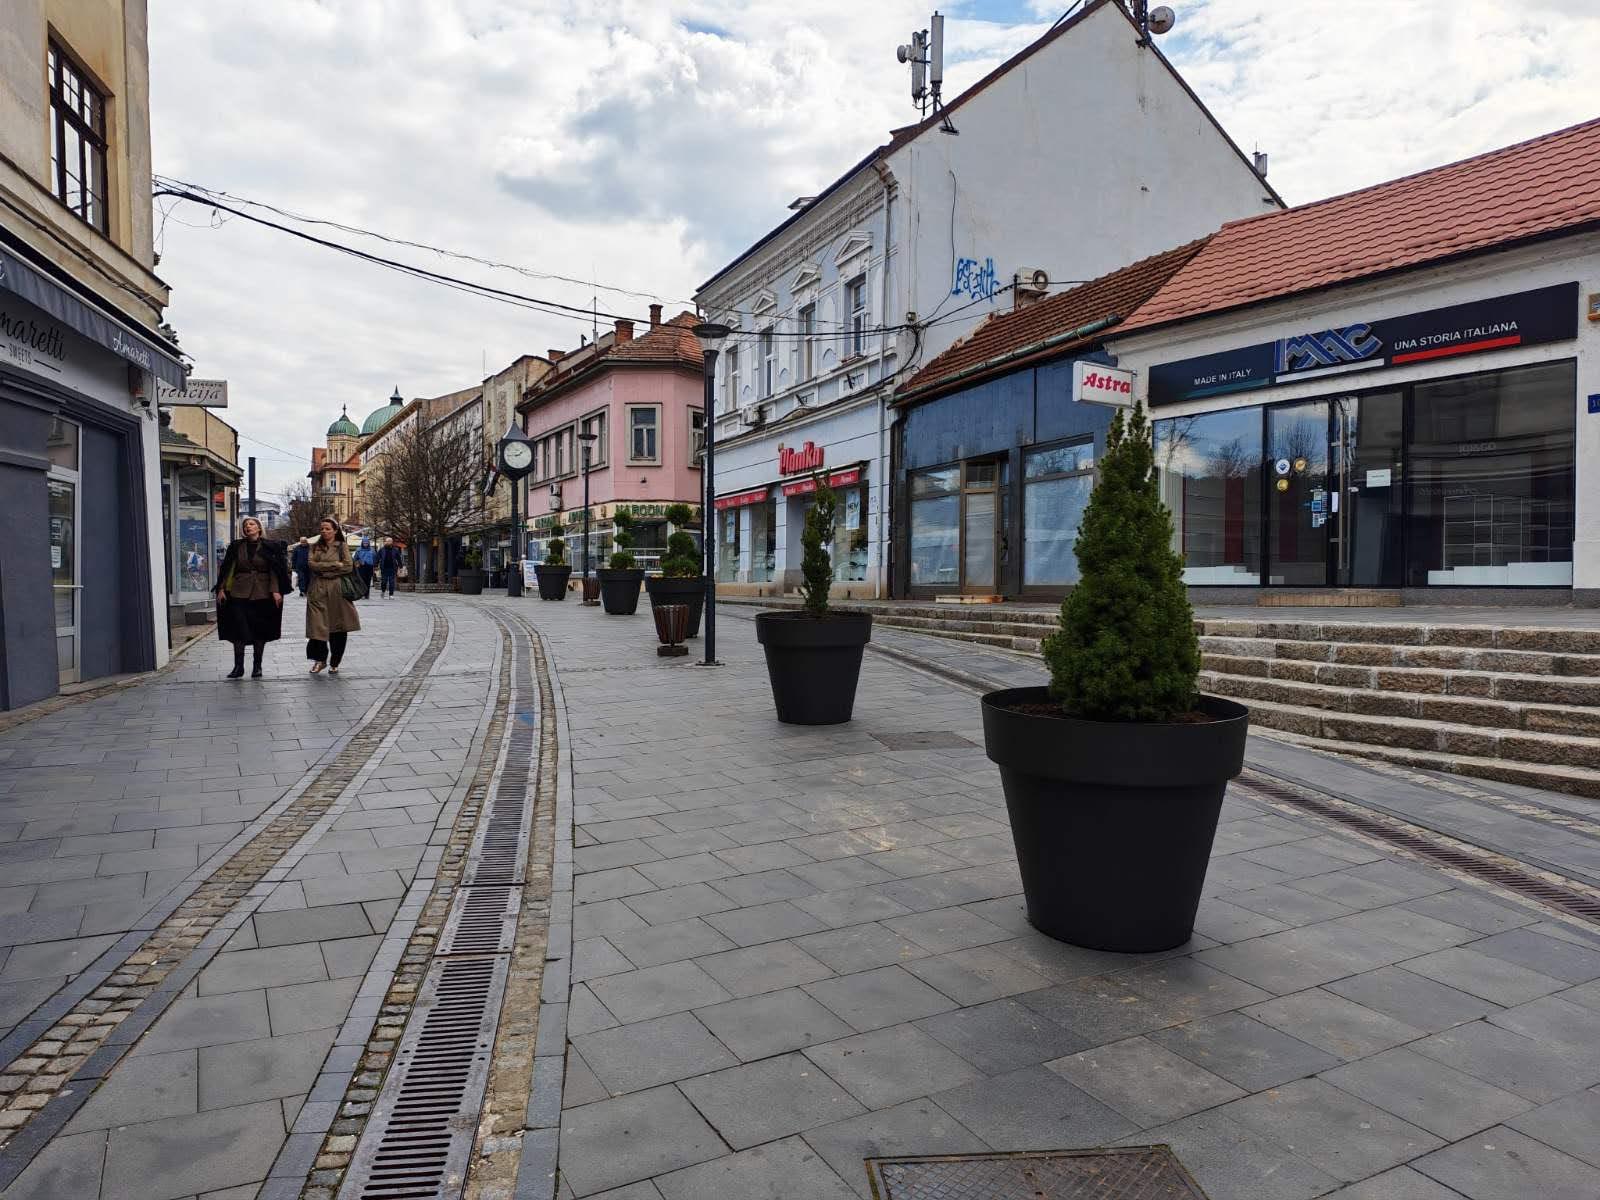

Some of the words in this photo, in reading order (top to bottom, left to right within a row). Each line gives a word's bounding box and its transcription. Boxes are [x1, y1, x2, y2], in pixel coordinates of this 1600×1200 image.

[1394, 340, 1418, 351] UNA
[1420, 332, 1461, 347] STORIA
[1464, 321, 1518, 339] ITALIANA
[8, 343, 32, 364] SWEETS
[113, 331, 151, 367] Amaretti
[1083, 373, 1131, 394] Astra
[1194, 375, 1217, 386] MADE
[1218, 373, 1227, 382] IN
[1228, 368, 1252, 380] ITALY
